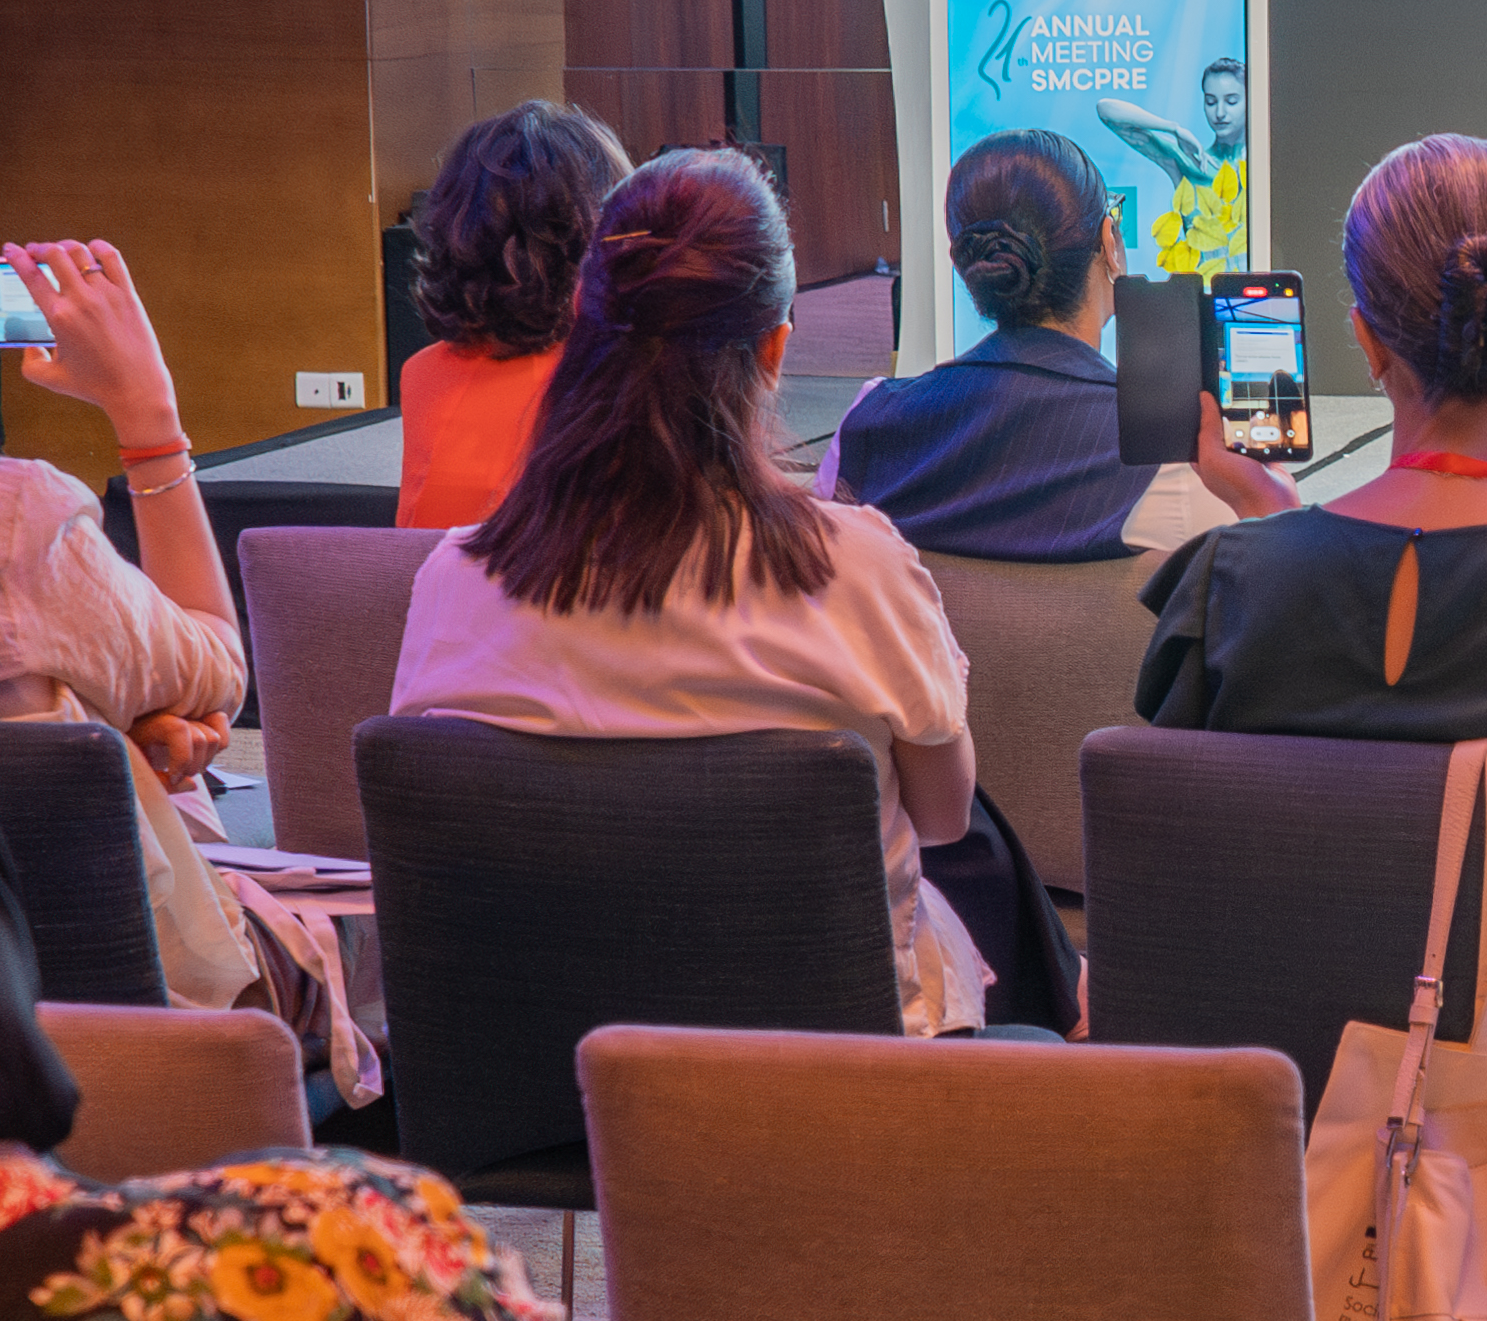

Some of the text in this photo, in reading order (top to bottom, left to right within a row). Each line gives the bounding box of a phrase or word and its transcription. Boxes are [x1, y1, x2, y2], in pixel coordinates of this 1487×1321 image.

[1030, 14, 1150, 37] ANNUAL
[1031, 40, 1154, 63] MEETING
[1031, 68, 1147, 93] SMCPRE
[1344, 1296, 1380, 1319] Soci
